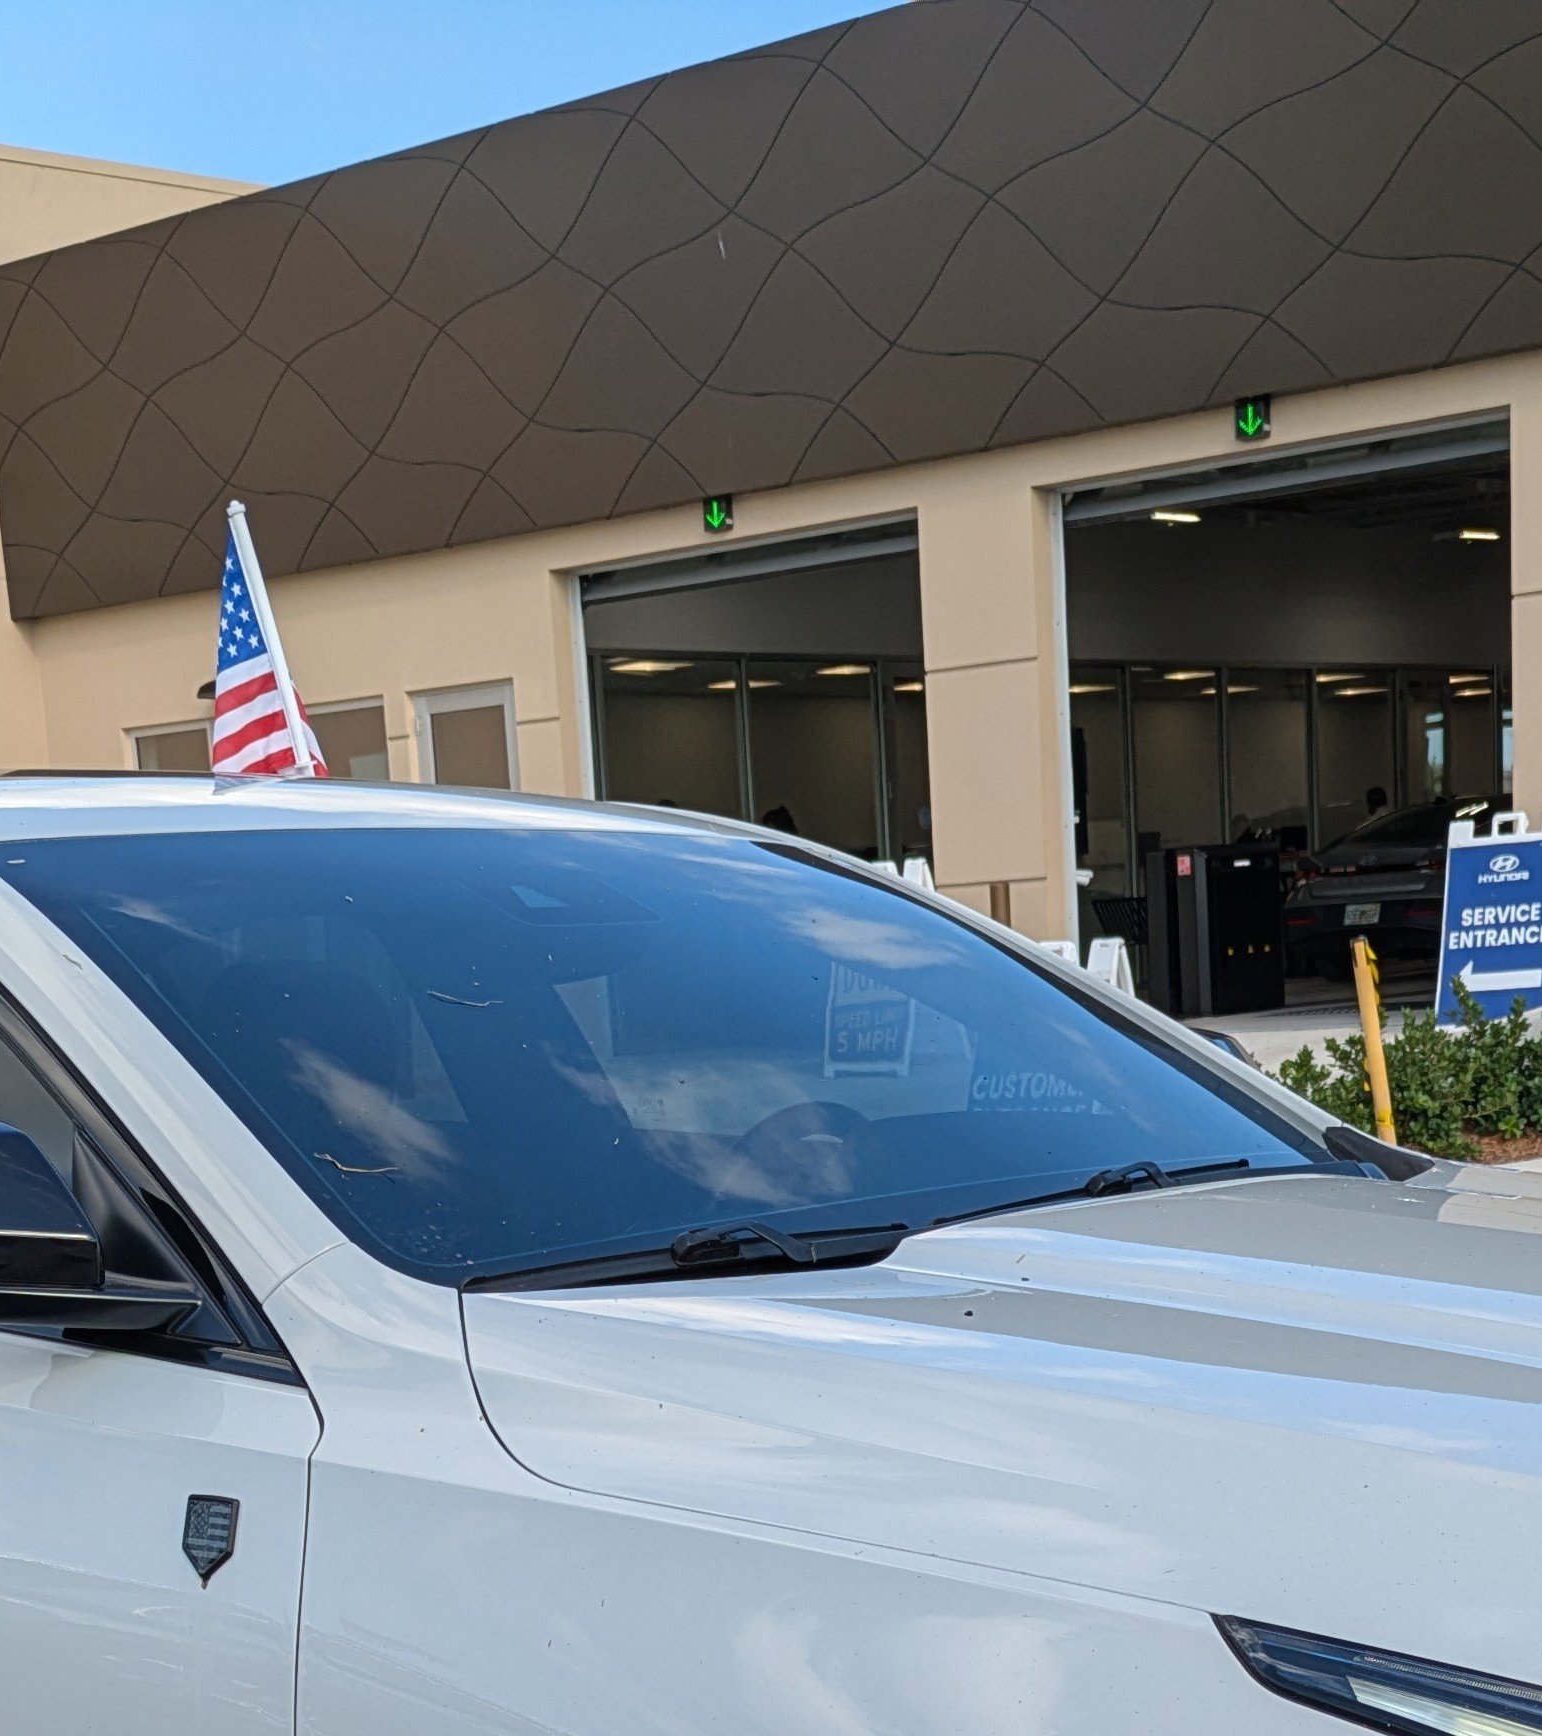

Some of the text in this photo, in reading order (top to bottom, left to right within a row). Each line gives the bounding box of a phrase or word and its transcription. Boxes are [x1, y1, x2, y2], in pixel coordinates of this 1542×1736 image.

[1478, 869, 1530, 884] HYUNDAI
[1461, 902, 1541, 927] SERVICE
[837, 1026, 899, 1053] 5 MPH
[972, 1071, 1084, 1100] CUSTOM
